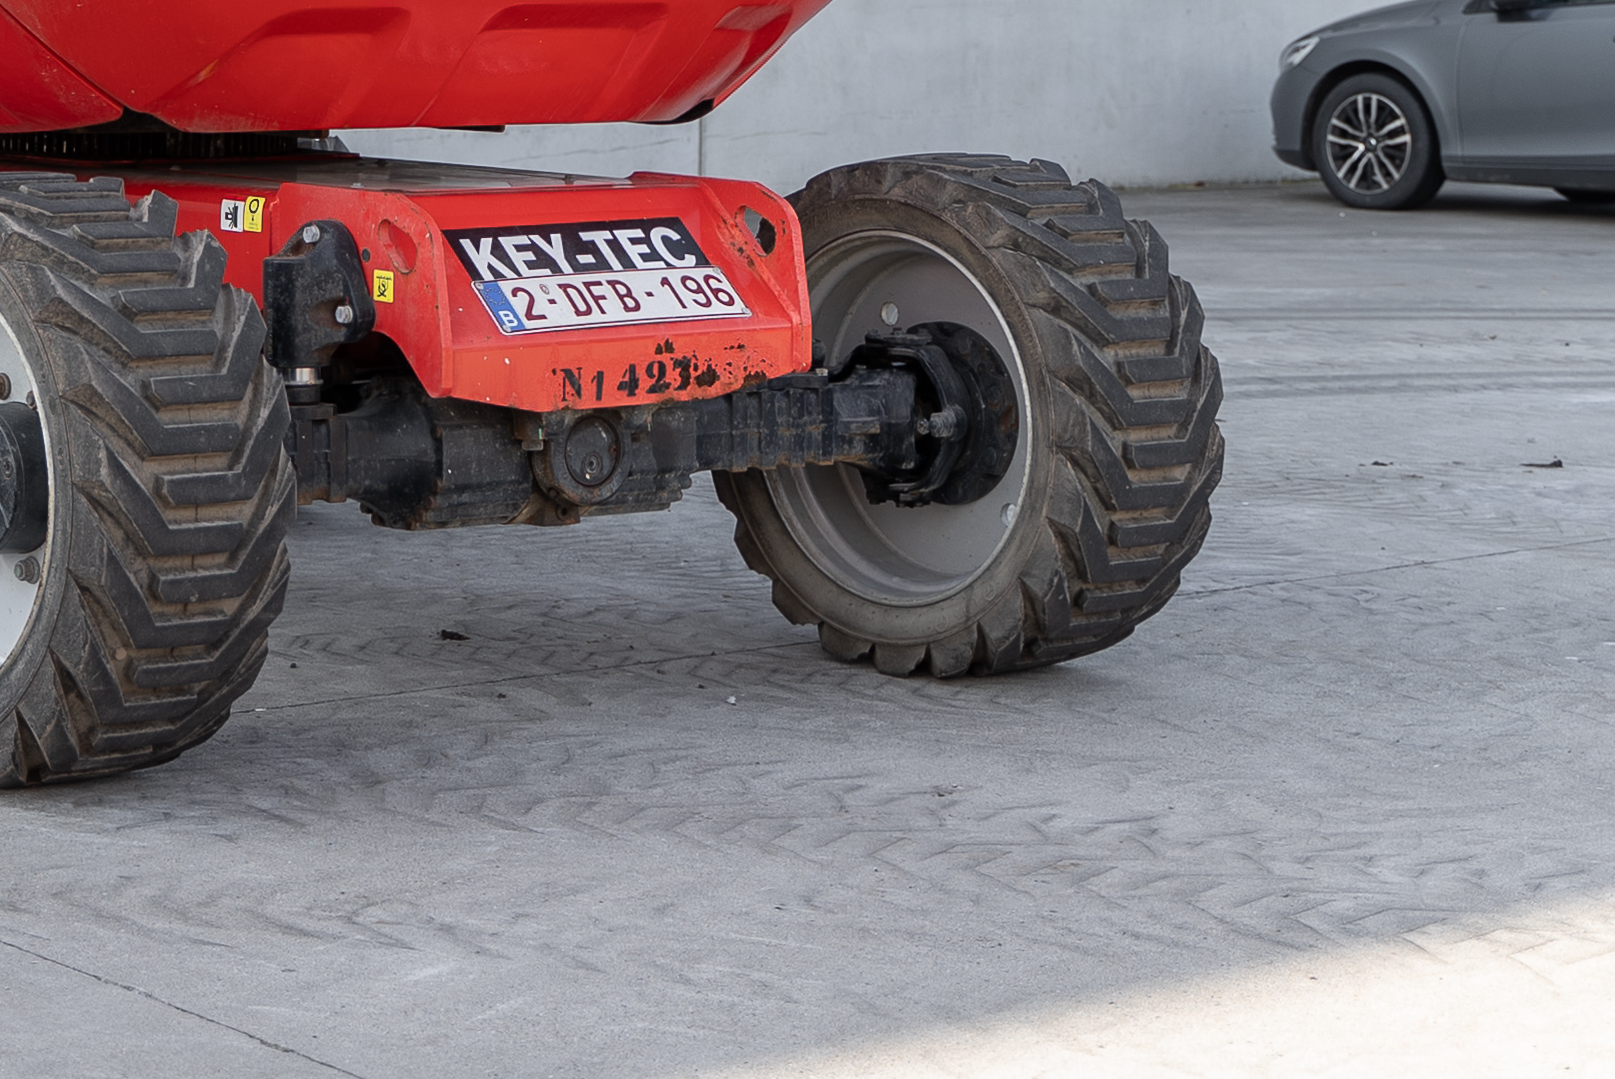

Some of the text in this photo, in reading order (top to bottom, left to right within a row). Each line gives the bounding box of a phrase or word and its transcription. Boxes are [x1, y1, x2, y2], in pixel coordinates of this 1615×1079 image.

[459, 226, 697, 281] KEY-TEC
[497, 273, 736, 327] B 2-DFB-196
